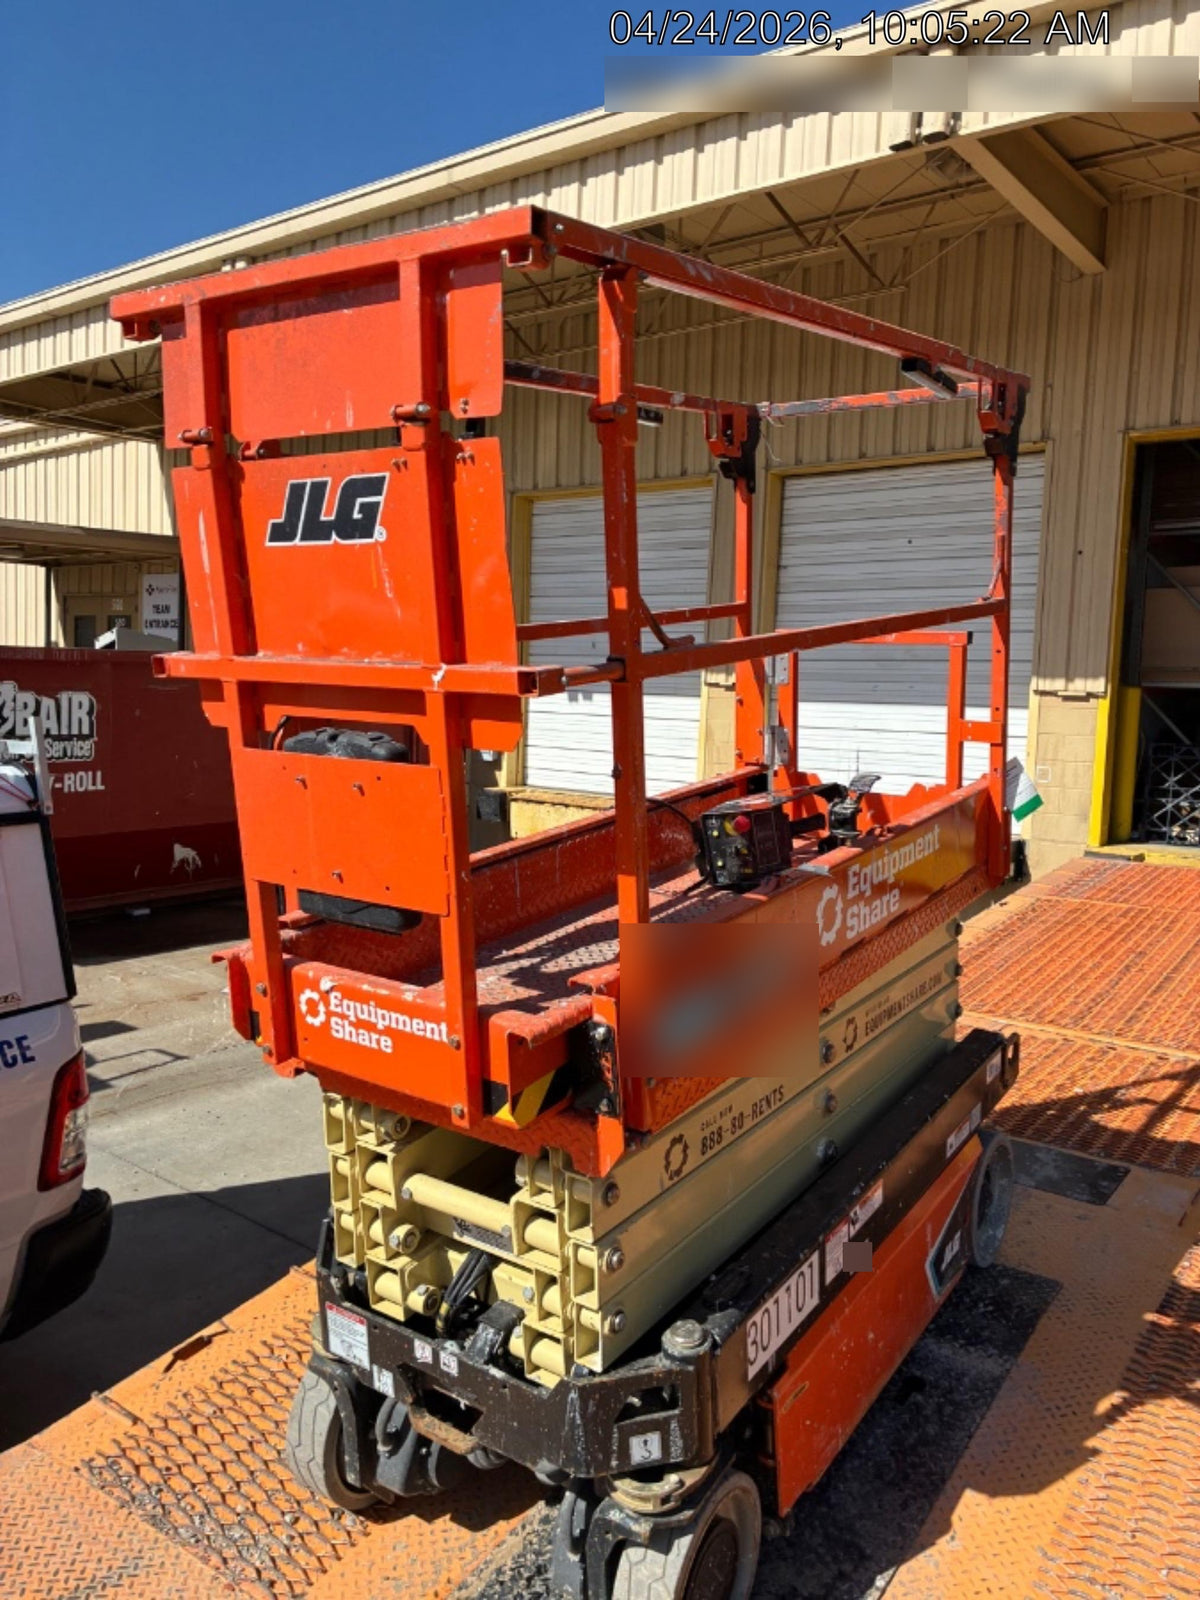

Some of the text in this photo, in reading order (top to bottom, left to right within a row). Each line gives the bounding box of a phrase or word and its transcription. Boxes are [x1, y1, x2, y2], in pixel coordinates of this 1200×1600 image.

[264, 471, 390, 547] JLG
[45, 738, 92, 759] Service
[847, 823, 941, 899] Equipment
[846, 887, 900, 940] Share
[329, 991, 449, 1043] Equipment
[330, 1016, 393, 1053] Share
[0, 1034, 36, 1070] CE
[701, 1084, 784, 1156] 888-80-RENTS
[749, 1261, 815, 1367] 301101
